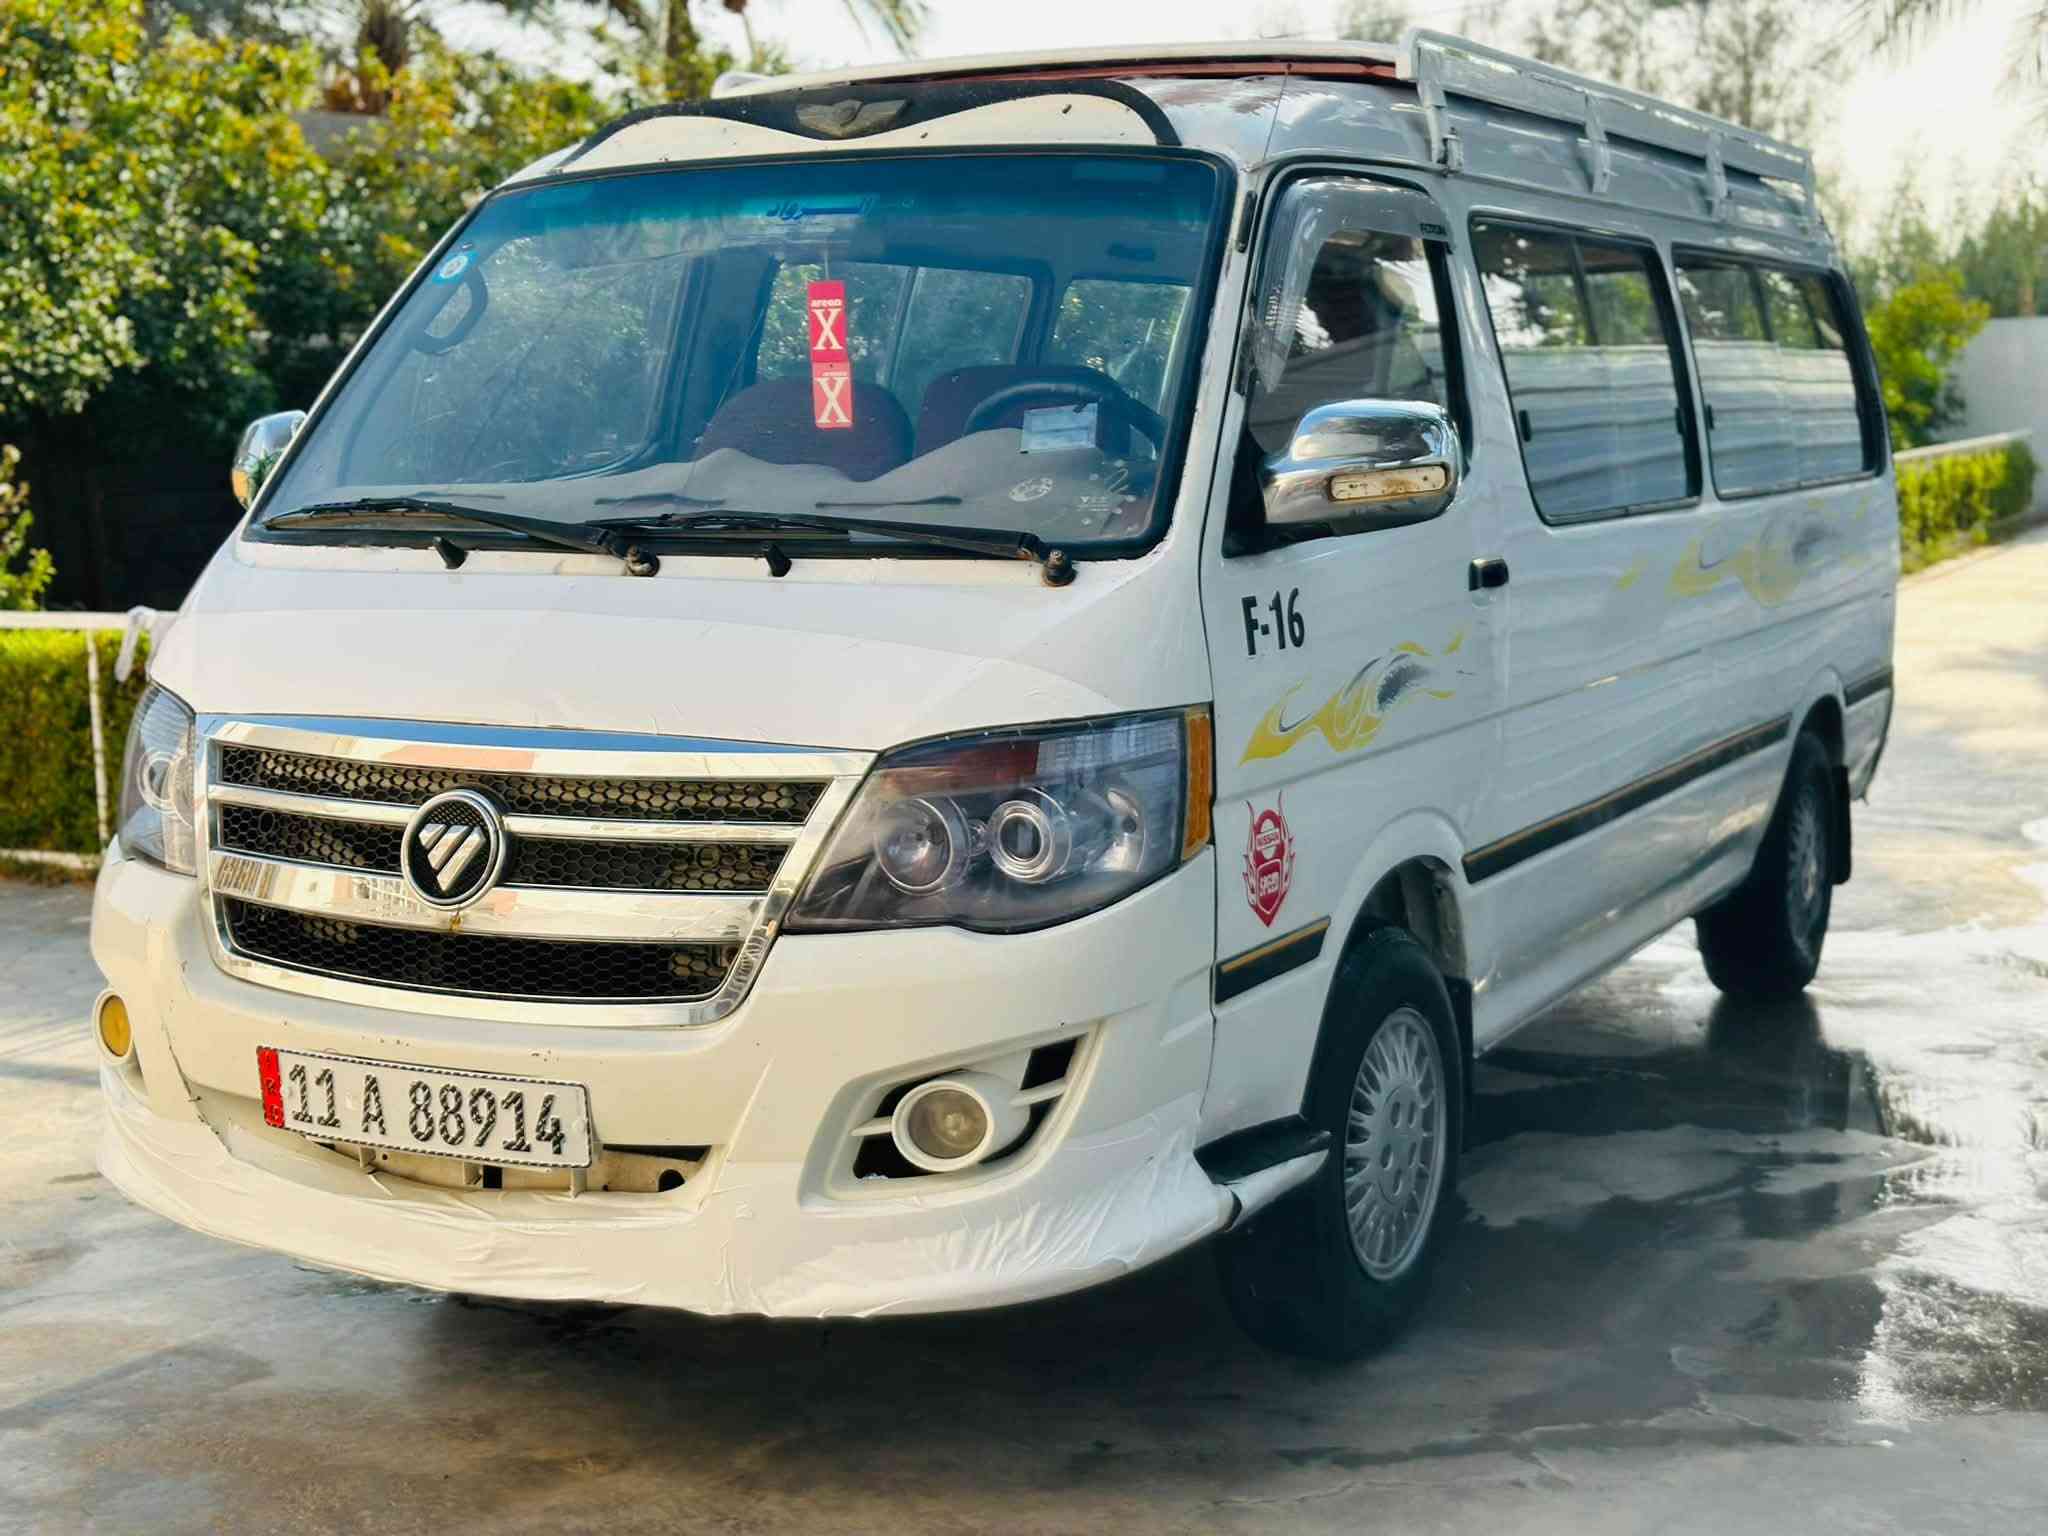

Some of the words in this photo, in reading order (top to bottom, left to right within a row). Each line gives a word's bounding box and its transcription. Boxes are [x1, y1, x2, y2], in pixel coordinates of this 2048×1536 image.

[812, 308, 844, 350] X
[815, 377, 851, 424] X
[1241, 587, 1305, 656] F-16
[288, 1064, 341, 1128] 11
[361, 1073, 387, 1136] A
[408, 1080, 565, 1155] 88914
